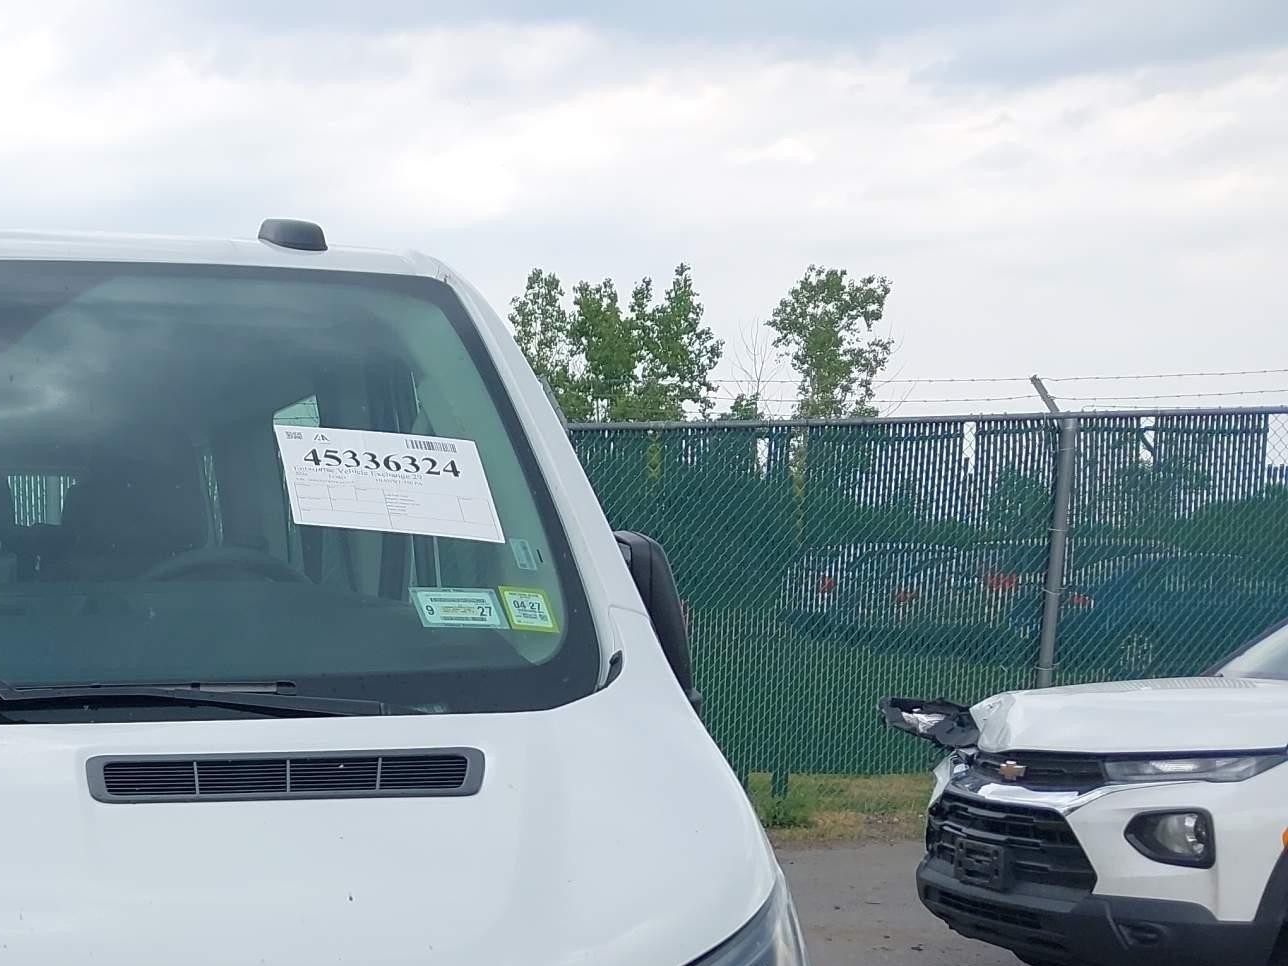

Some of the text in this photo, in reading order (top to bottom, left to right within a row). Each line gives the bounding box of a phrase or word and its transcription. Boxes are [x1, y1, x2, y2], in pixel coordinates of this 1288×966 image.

[304, 448, 461, 478] 45336324
[426, 604, 435, 616] 9
[477, 605, 492, 616] 27
